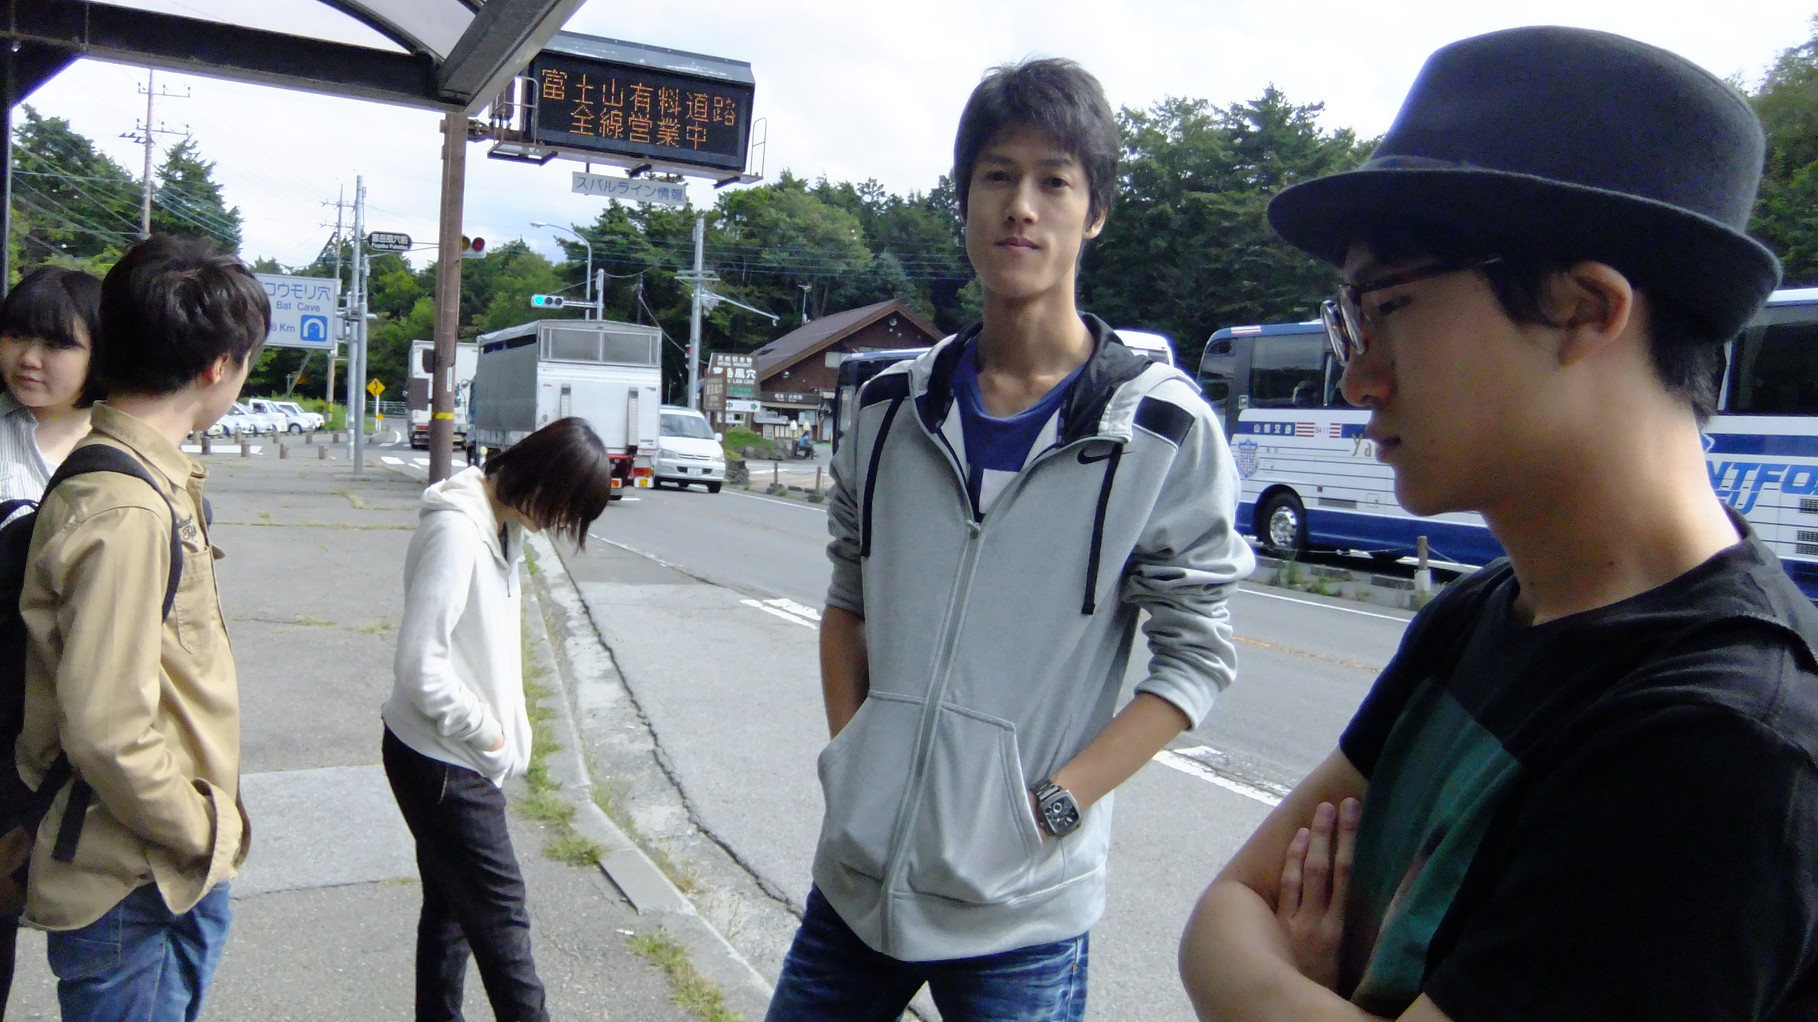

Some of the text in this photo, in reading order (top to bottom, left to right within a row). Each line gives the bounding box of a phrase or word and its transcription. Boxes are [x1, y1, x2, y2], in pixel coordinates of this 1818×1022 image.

[541, 68, 736, 127] 富士山有料道路
[569, 104, 707, 150] 全線営業中
[576, 176, 684, 201] スバルライン情報
[259, 281, 331, 302] コウモリ穴
[276, 300, 321, 312] Bat Cave
[279, 323, 296, 332] Km
[1706, 460, 1818, 496] NTFO
